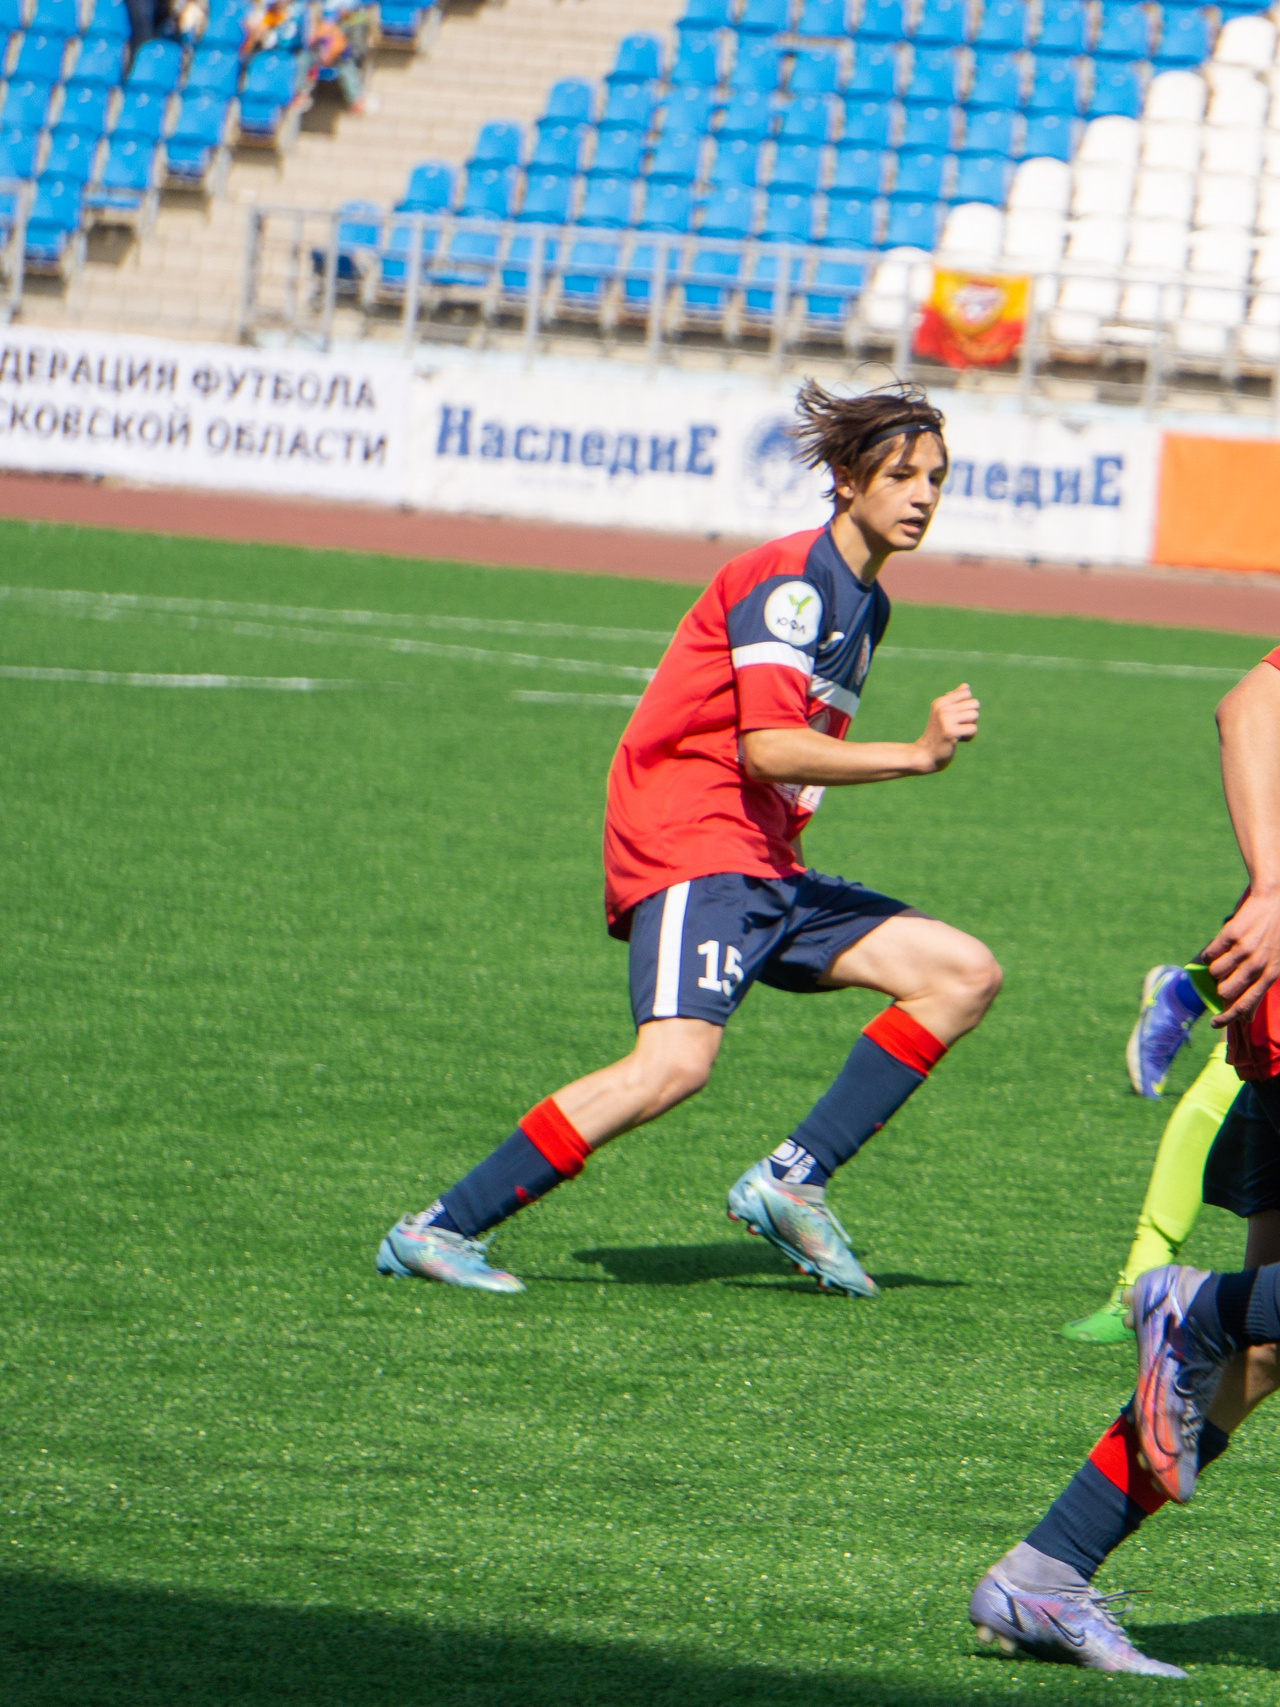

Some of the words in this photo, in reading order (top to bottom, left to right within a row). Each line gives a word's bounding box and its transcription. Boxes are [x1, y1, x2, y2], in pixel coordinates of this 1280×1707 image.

[190, 361, 376, 411] ФУТБОЛА
[205, 417, 389, 465] ОБЛАСТИ
[436, 404, 718, 477] НаследиЕ
[942, 456, 1123, 510] ледиЕ
[697, 939, 744, 997] 15
